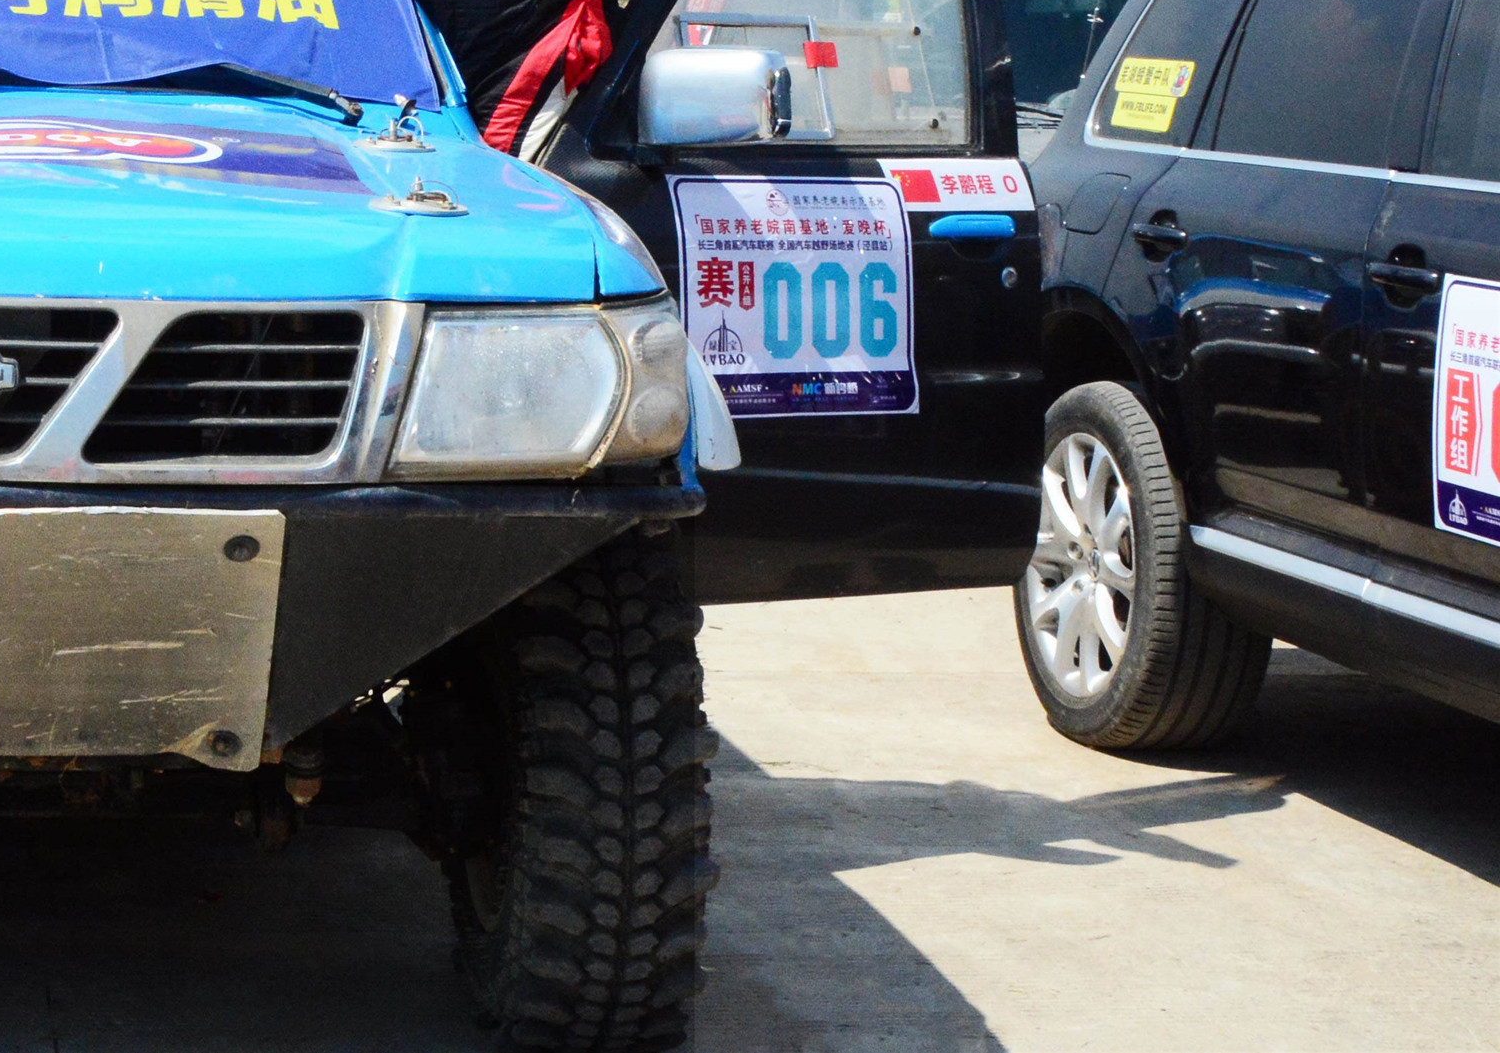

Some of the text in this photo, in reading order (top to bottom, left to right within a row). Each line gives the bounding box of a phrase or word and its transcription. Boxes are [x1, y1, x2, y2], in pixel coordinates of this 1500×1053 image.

[940, 174, 997, 195] 李鹏程
[696, 257, 735, 308] 赛
[763, 261, 898, 360] 006
[730, 383, 763, 393] AAMSF
[792, 382, 821, 396] NMC
[1450, 374, 1470, 470] 工作组
